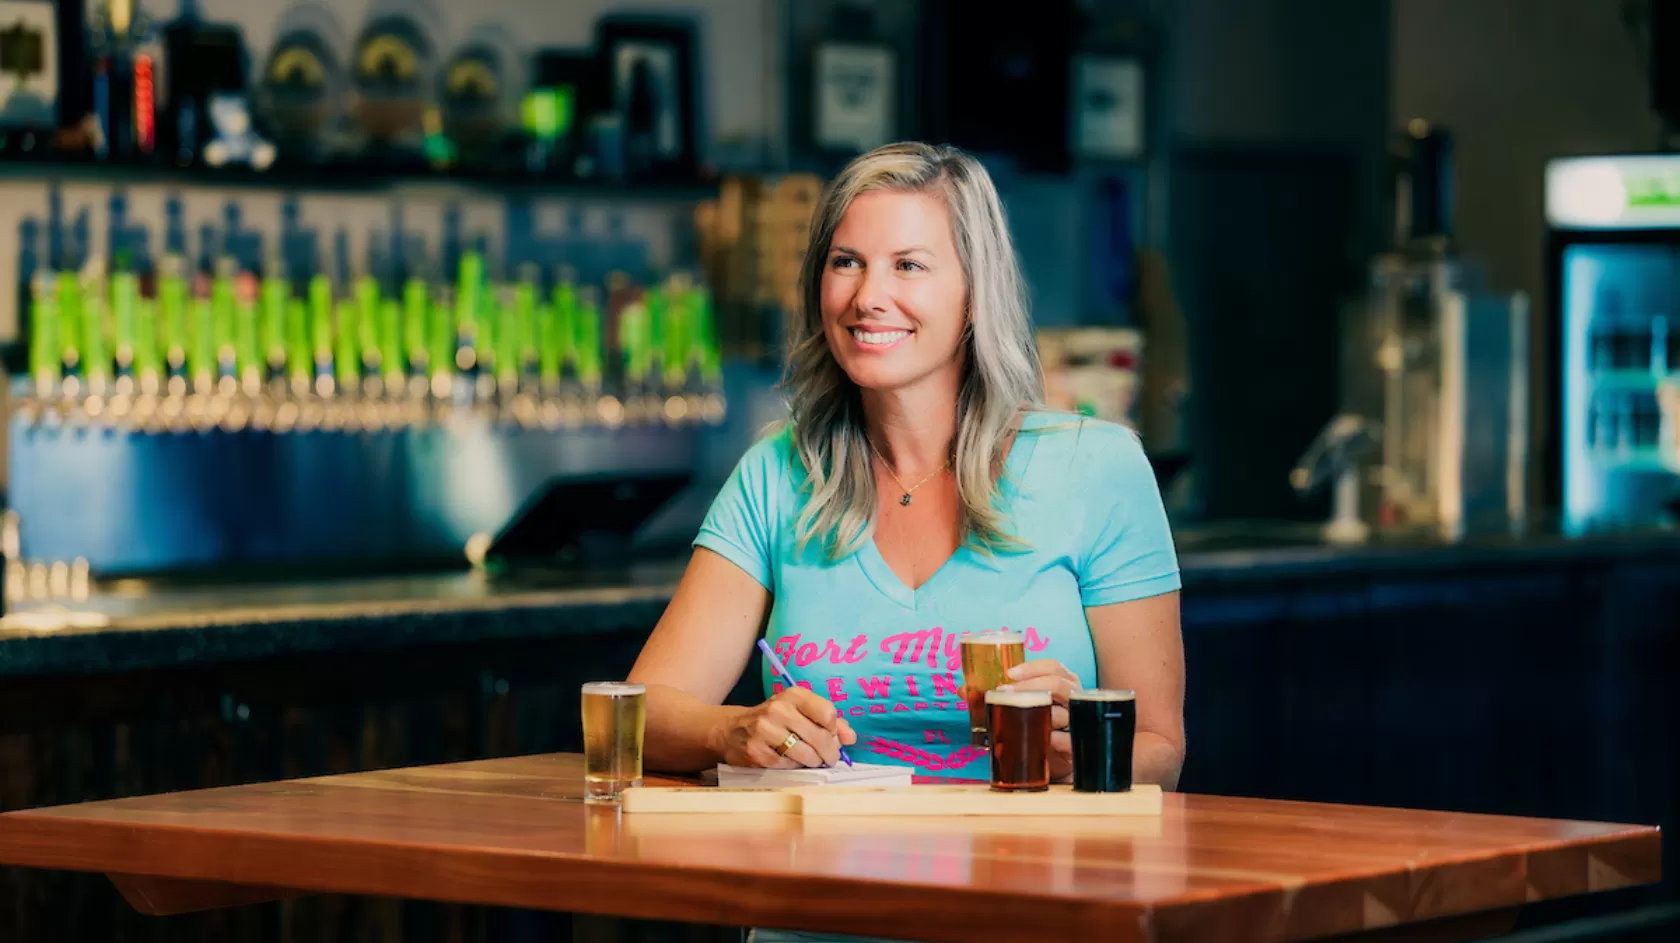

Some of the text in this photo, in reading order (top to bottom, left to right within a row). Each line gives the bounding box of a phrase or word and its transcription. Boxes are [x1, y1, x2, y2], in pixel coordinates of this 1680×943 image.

[772, 626, 1050, 676] Fort Mys
[772, 672, 958, 703] EWIN
[924, 730, 952, 744] FL
